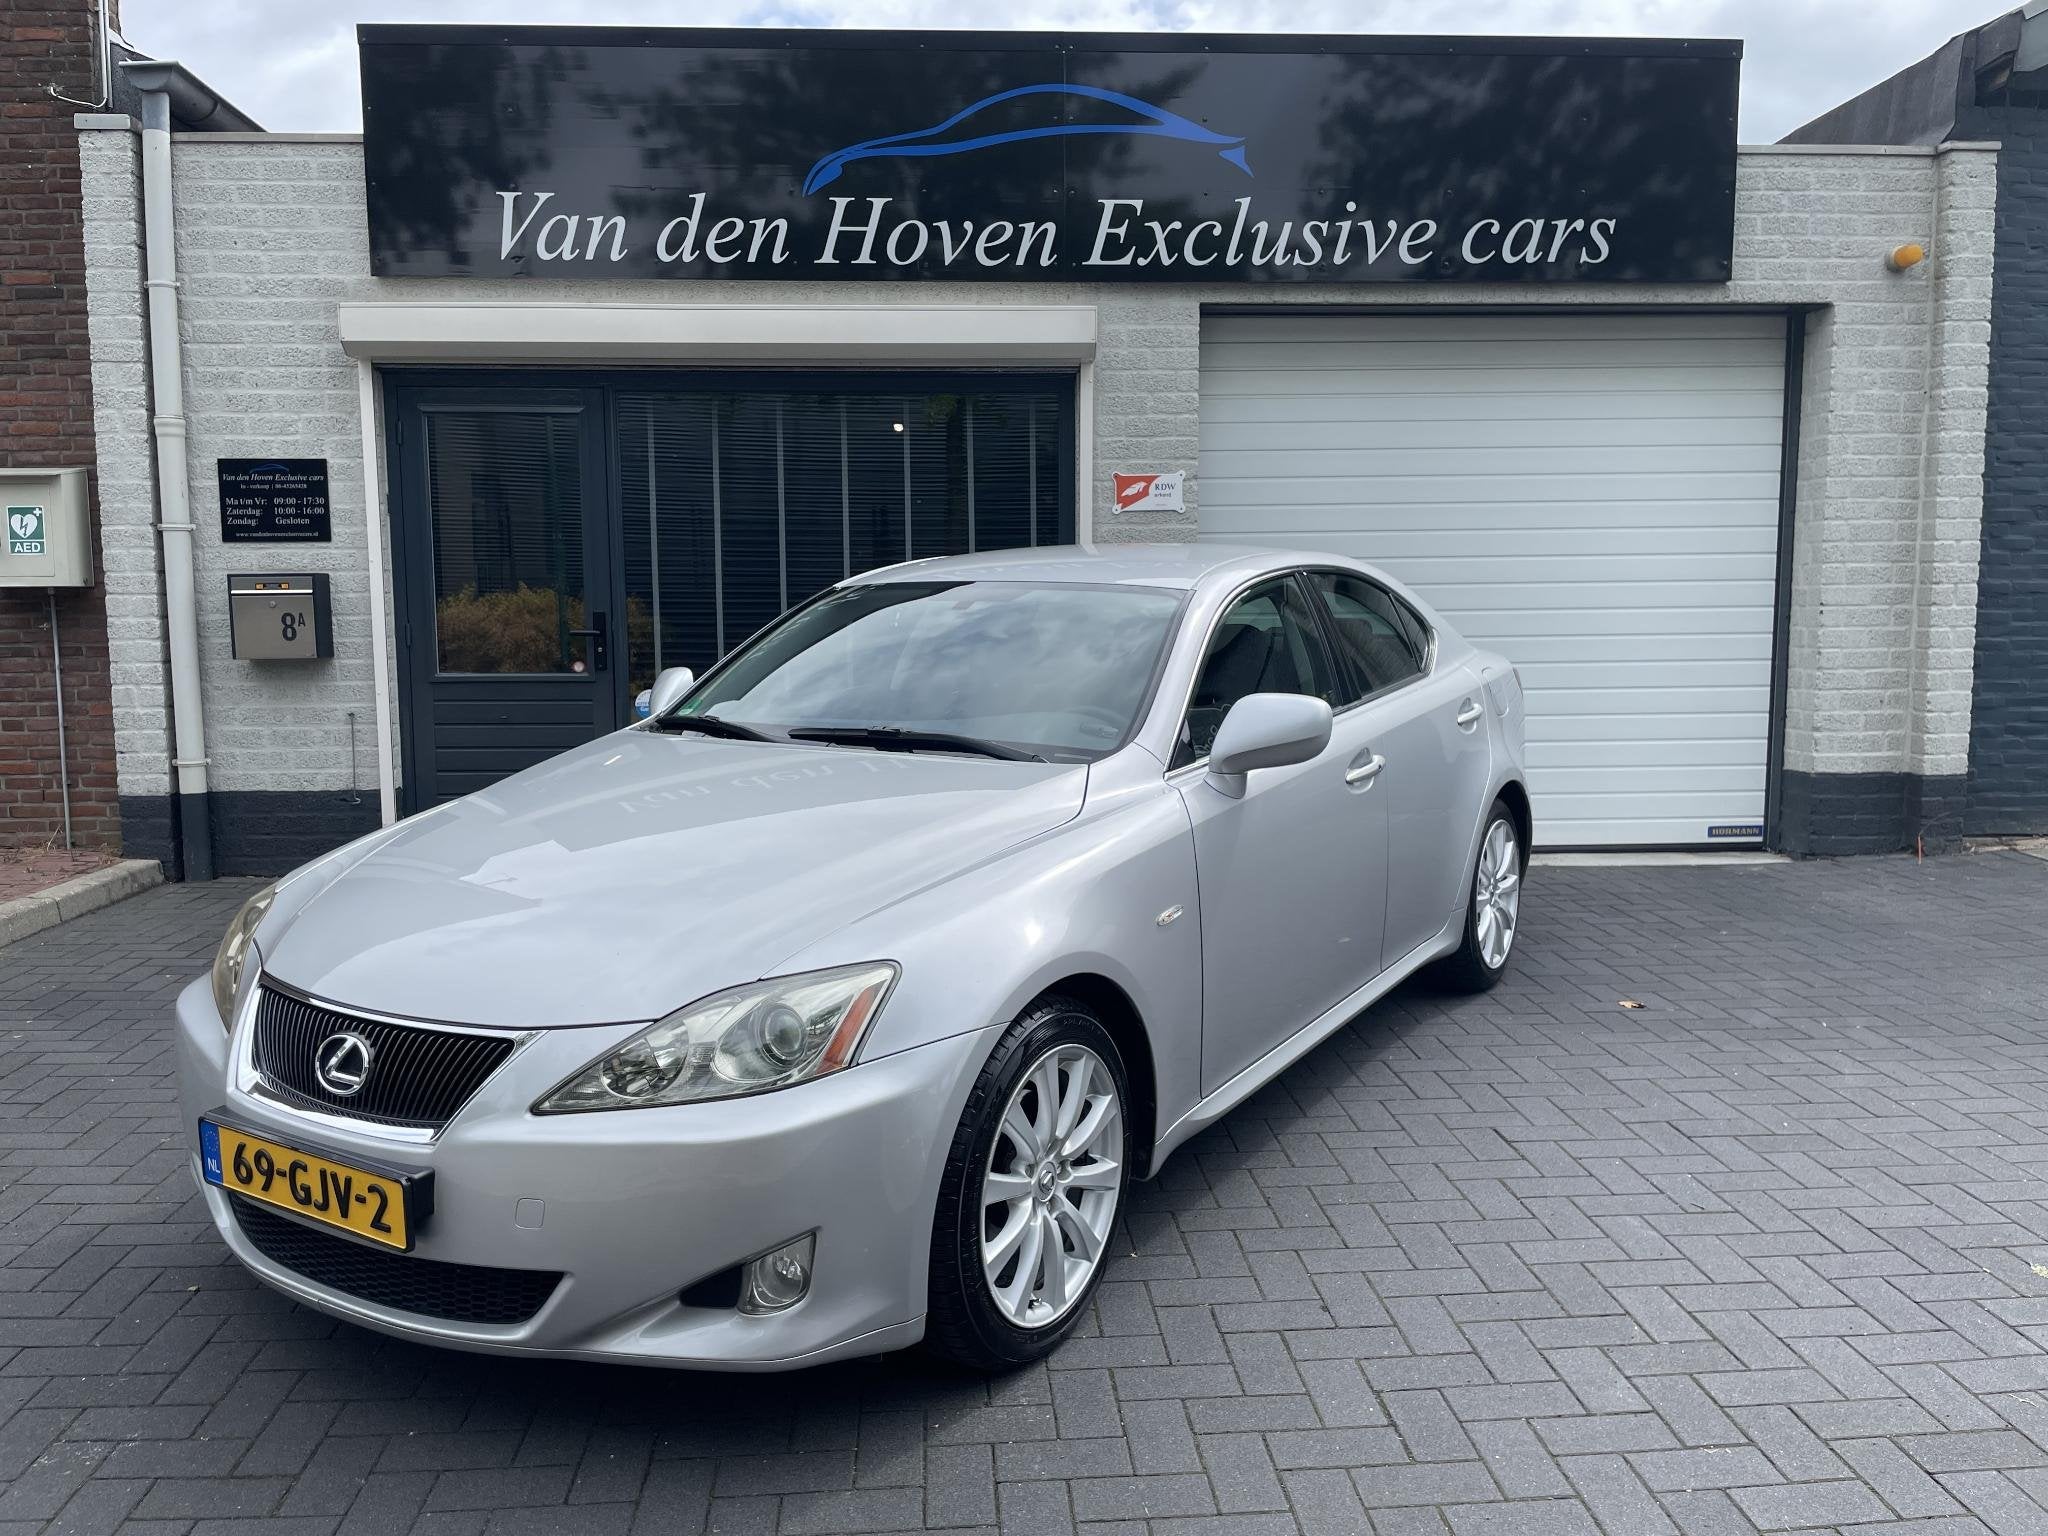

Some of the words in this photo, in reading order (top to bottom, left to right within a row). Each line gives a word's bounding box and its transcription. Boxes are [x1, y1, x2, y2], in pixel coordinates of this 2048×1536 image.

[496, 191, 628, 262] Van
[655, 192, 790, 264] den
[814, 197, 1057, 266] Hoven
[1082, 196, 1437, 266] Exclusive
[1461, 217, 1617, 264] cars
[222, 473, 236, 481] Van
[236, 473, 250, 481] den
[250, 473, 273, 481] Hoven
[275, 473, 308, 481] Exclusive
[225, 497, 239, 506] Ma
[240, 497, 253, 506] t/m
[255, 497, 268, 506] Vr:
[273, 497, 296, 505] 09:00
[303, 497, 325, 505] 17:30
[226, 507, 264, 517] Zaterdag:
[274, 507, 296, 515] 10:00
[303, 507, 325, 515] 16:00
[227, 517, 259, 527] Zondag:
[275, 516, 310, 525] Gesloten
[14, 542, 41, 553] AED
[280, 612, 306, 642] 8A
[207, 1157, 221, 1174] NL
[232, 1141, 392, 1234] 69-GJV-2
